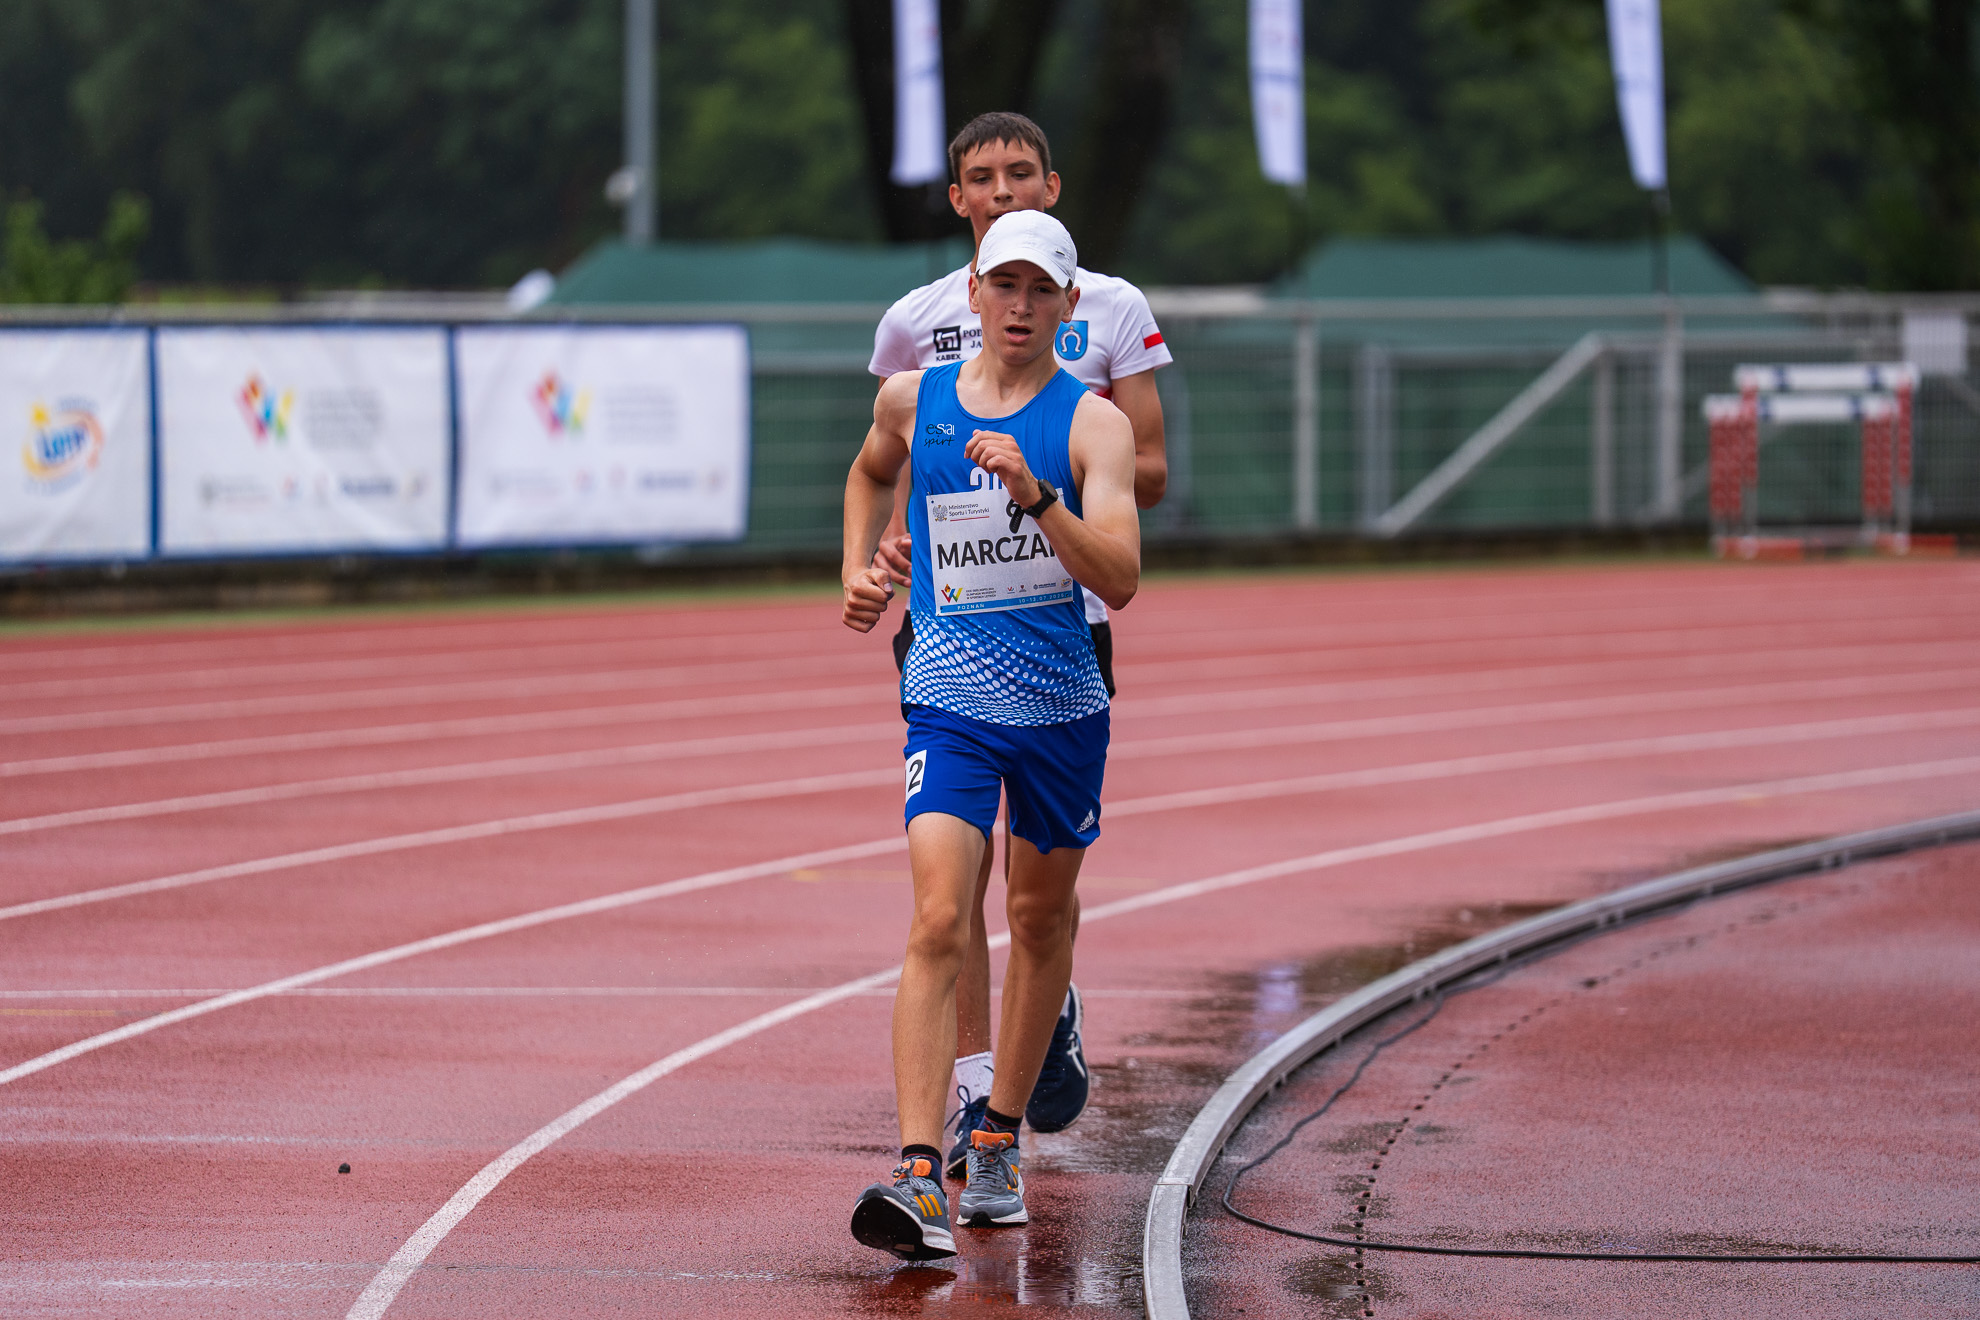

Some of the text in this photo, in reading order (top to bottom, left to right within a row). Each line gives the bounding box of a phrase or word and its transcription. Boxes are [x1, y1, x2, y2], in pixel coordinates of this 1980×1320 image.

[936, 353, 961, 361] KABEX
[968, 507, 990, 515] Turystyki
[908, 759, 923, 792] 2
